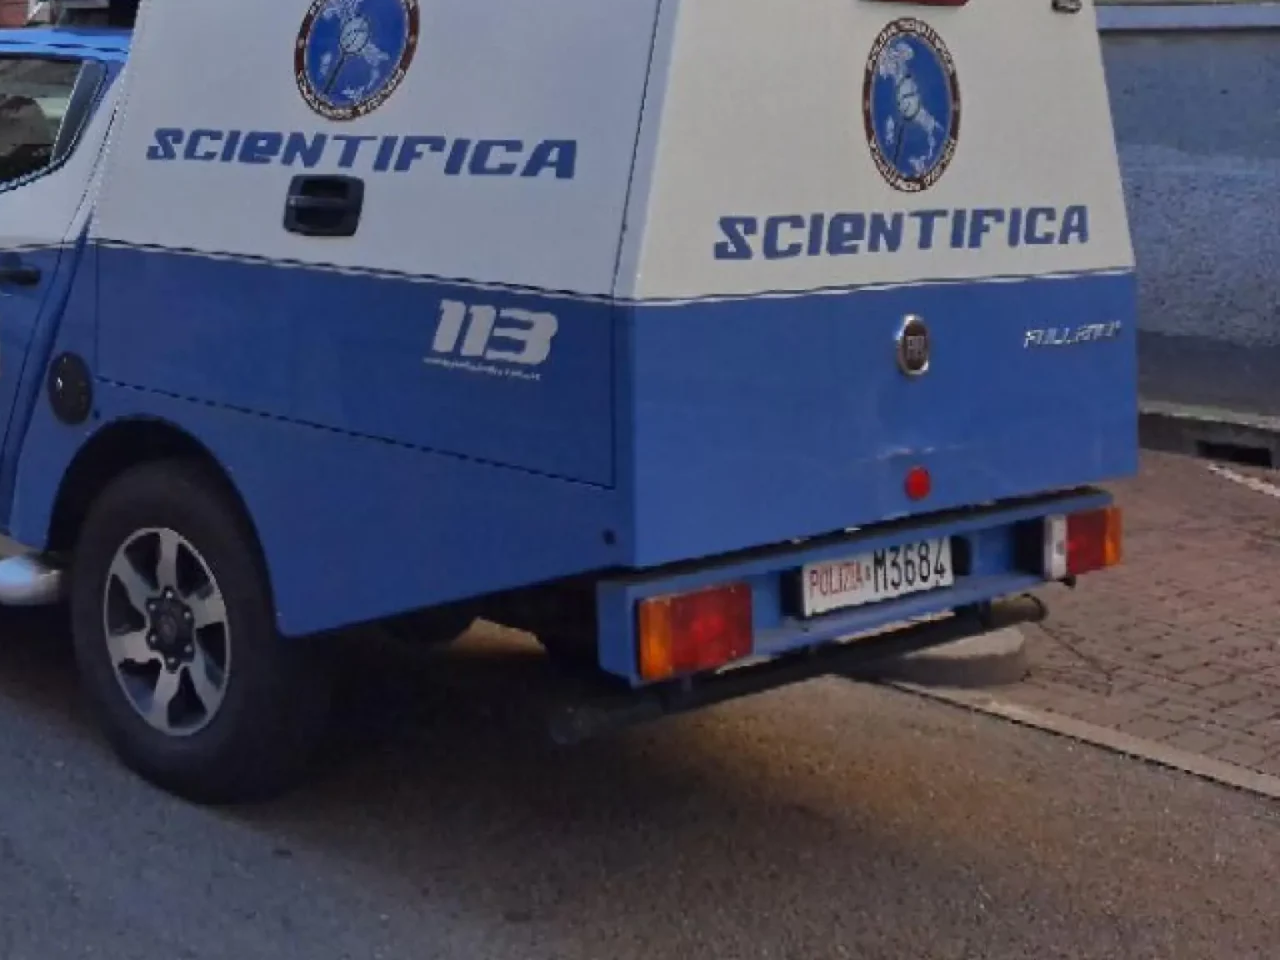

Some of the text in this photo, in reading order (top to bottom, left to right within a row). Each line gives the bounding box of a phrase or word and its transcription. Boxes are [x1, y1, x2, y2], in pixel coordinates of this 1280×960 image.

[432, 299, 558, 365] 113
[809, 541, 947, 598] POLIZIA M3684
